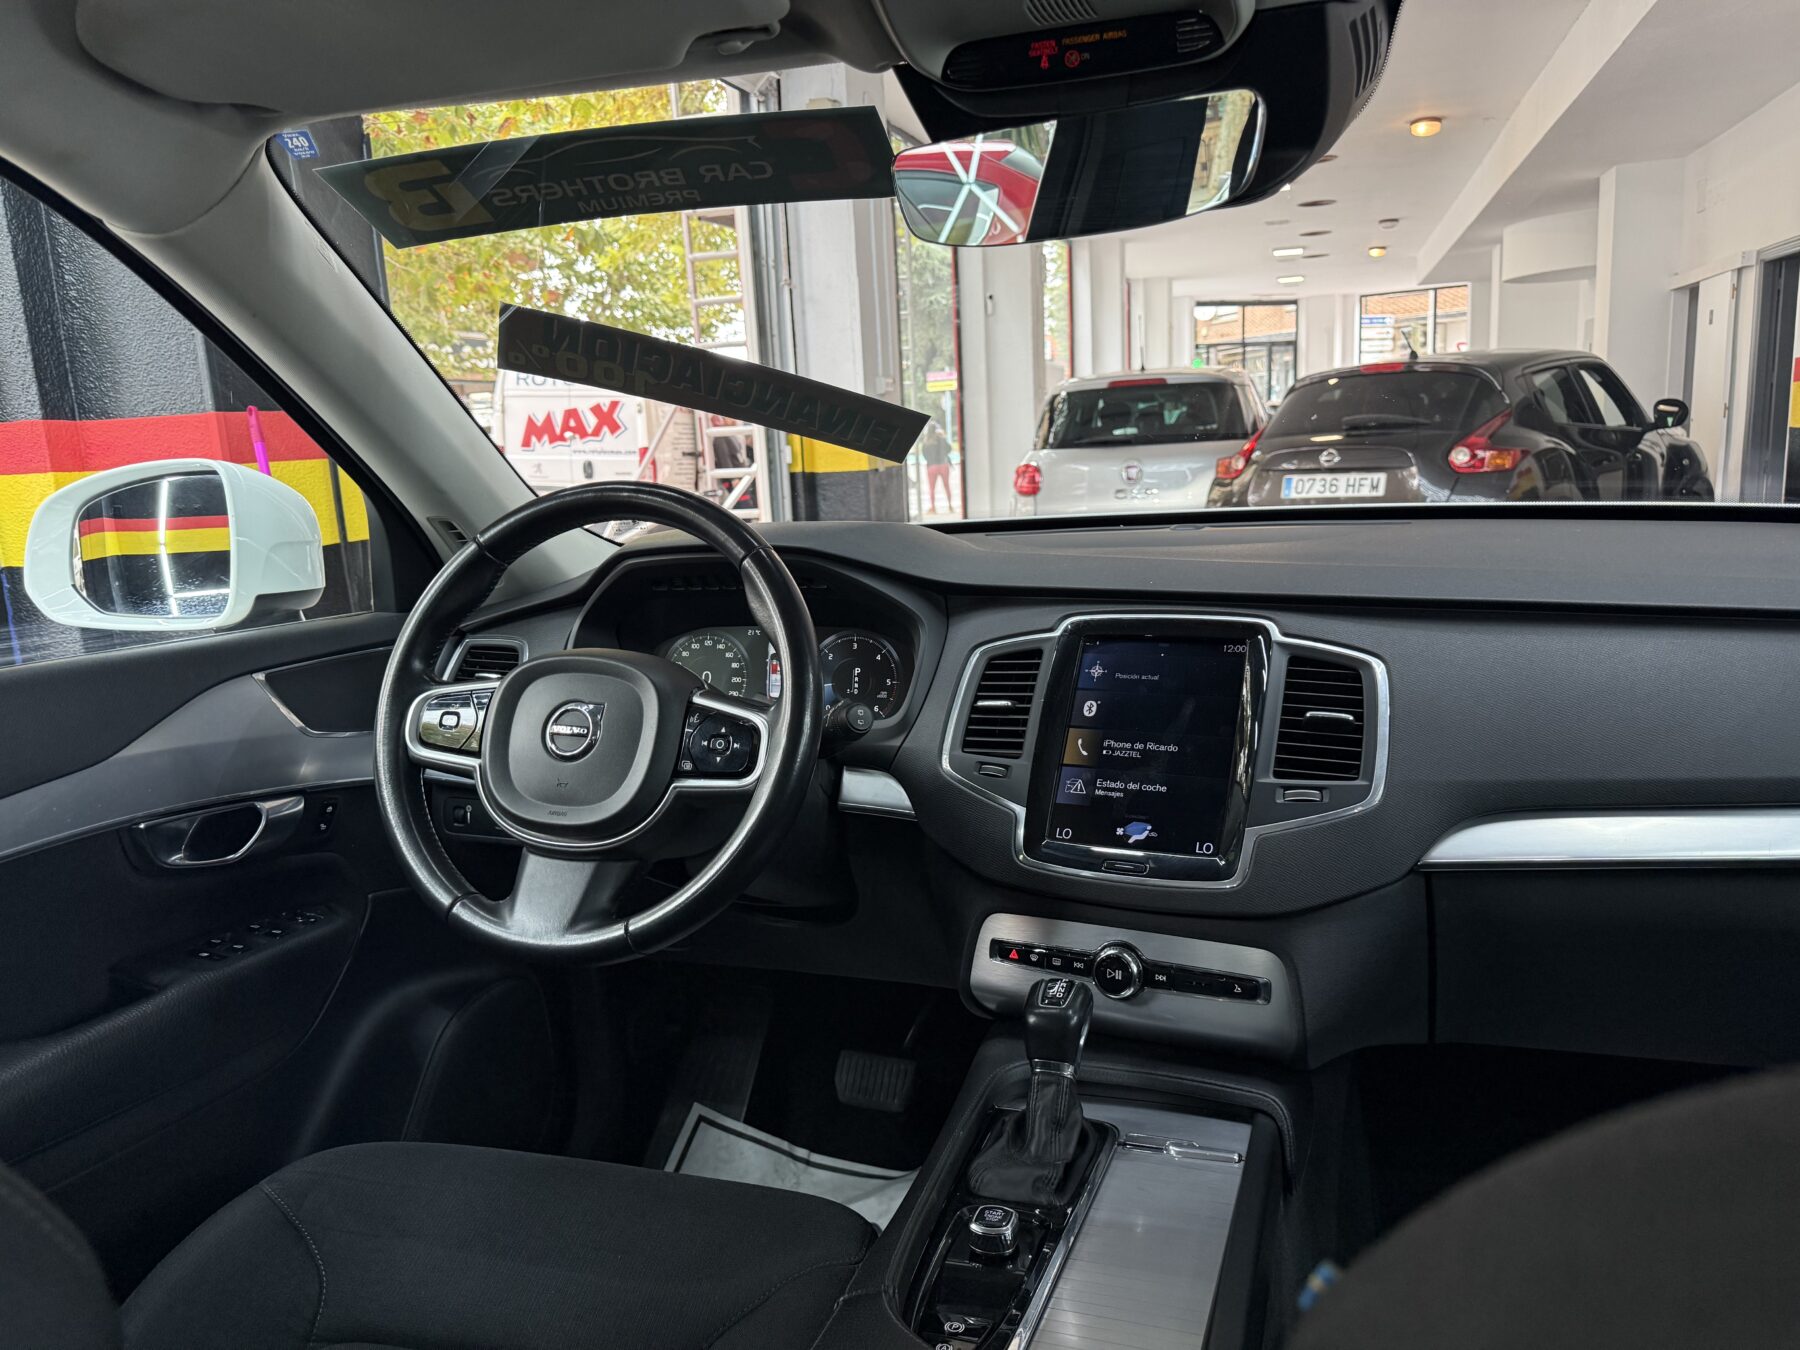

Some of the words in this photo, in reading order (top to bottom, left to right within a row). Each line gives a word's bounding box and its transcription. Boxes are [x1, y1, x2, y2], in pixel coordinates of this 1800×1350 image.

[1062, 33, 1100, 45] PASSENGER
[1103, 29, 1127, 40] AIRBAG
[1030, 39, 1056, 49] FASTEN
[284, 137, 309, 149] 240
[520, 399, 625, 450] MAX
[1294, 477, 1338, 495] 0736
[852, 642, 858, 650] 3
[1223, 644, 1247, 653] 12:00
[854, 667, 861, 676] P
[1115, 672, 1140, 680] Posición
[549, 724, 588, 735] VOLVO
[1103, 739, 1132, 749] iPhone
[1133, 741, 1144, 750] de
[1146, 742, 1179, 752] Ricardo
[1112, 750, 1142, 758] JAZZTEL
[1096, 779, 1125, 789] Estado
[1127, 781, 1140, 790] del
[1142, 783, 1168, 792] coche
[1095, 789, 1124, 798] Mensajes
[1056, 827, 1073, 839] LO
[1195, 842, 1214, 854] LO
